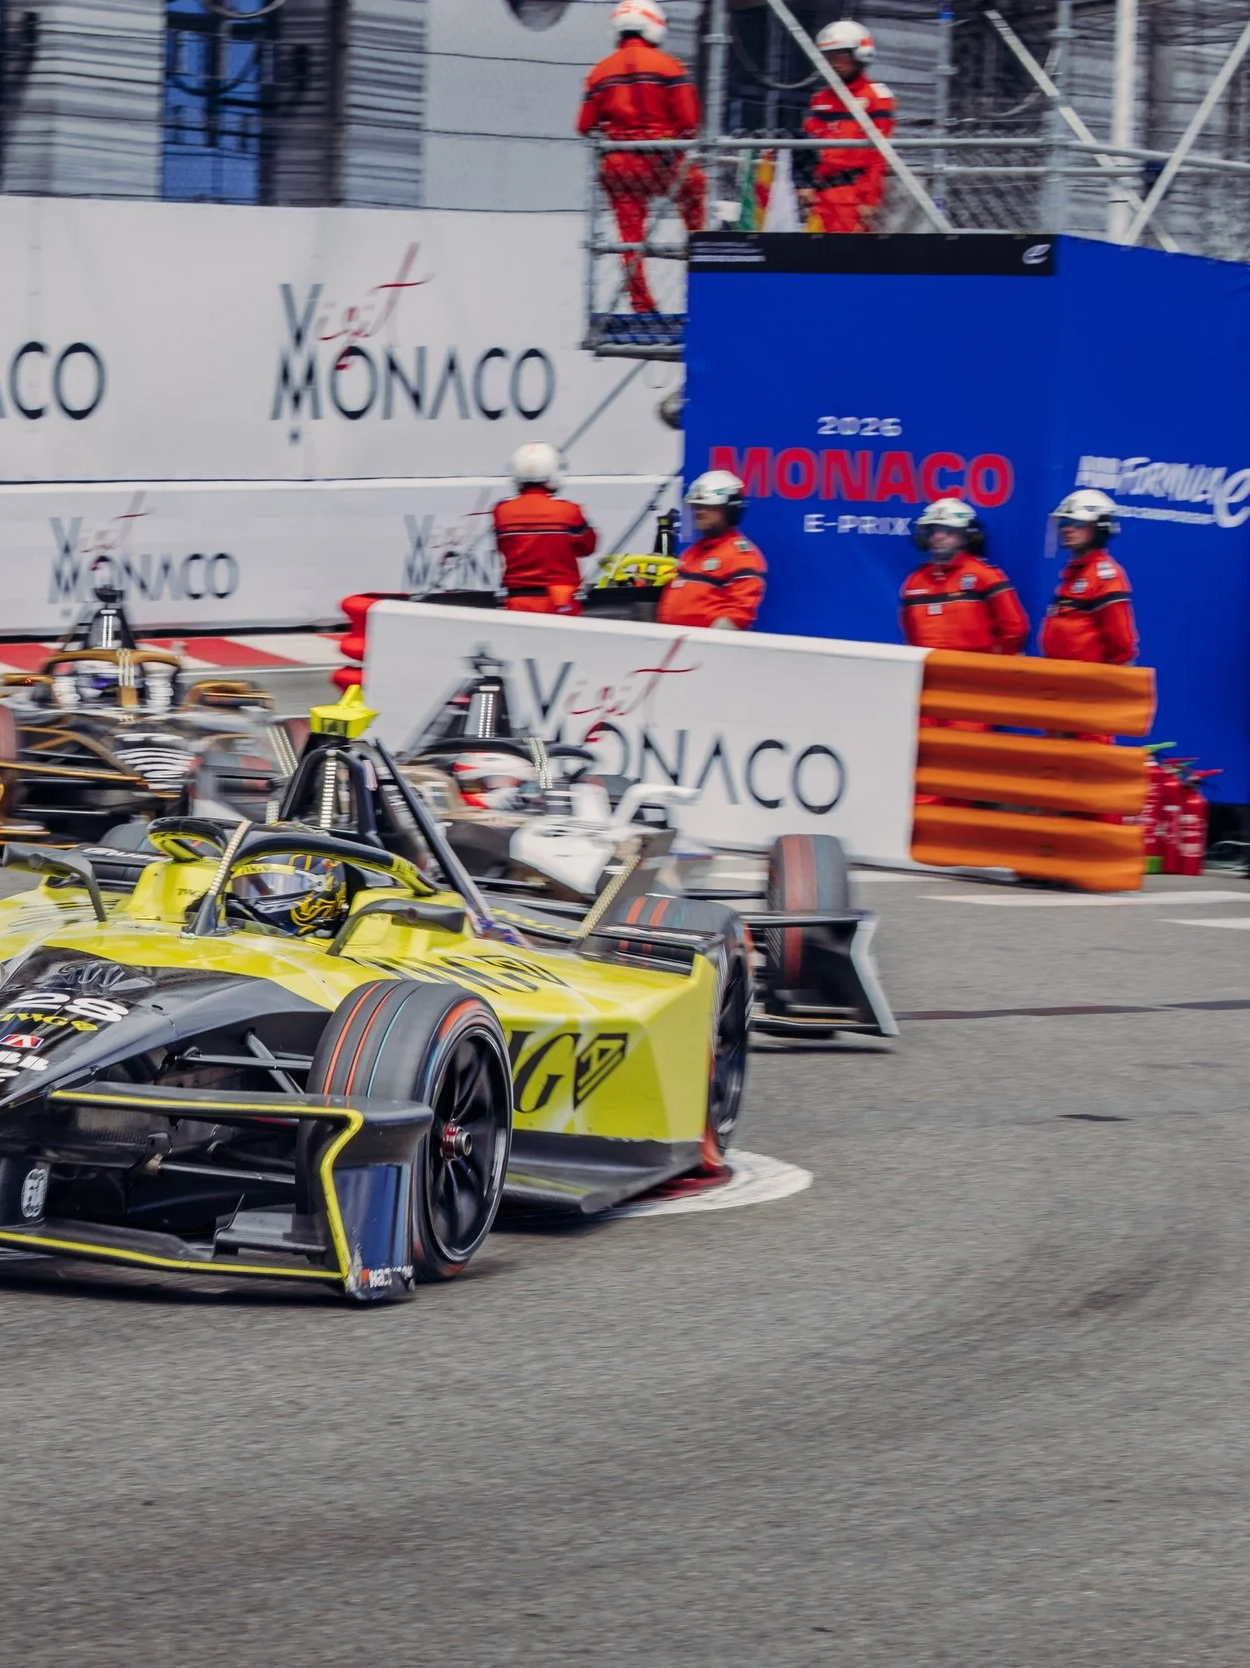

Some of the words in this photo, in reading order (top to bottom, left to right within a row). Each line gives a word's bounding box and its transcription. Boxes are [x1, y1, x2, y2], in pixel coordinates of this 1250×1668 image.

[278, 241, 436, 371] Visit
[270, 346, 557, 421] MONACO
[816, 415, 903, 437] 2026
[709, 446, 1016, 508] MONACO
[803, 513, 913, 536] E-PRIX
[47, 552, 241, 605] MONACO
[521, 634, 704, 743] Visit
[550, 721, 849, 815] ONACO
[6, 991, 130, 1023] 28
